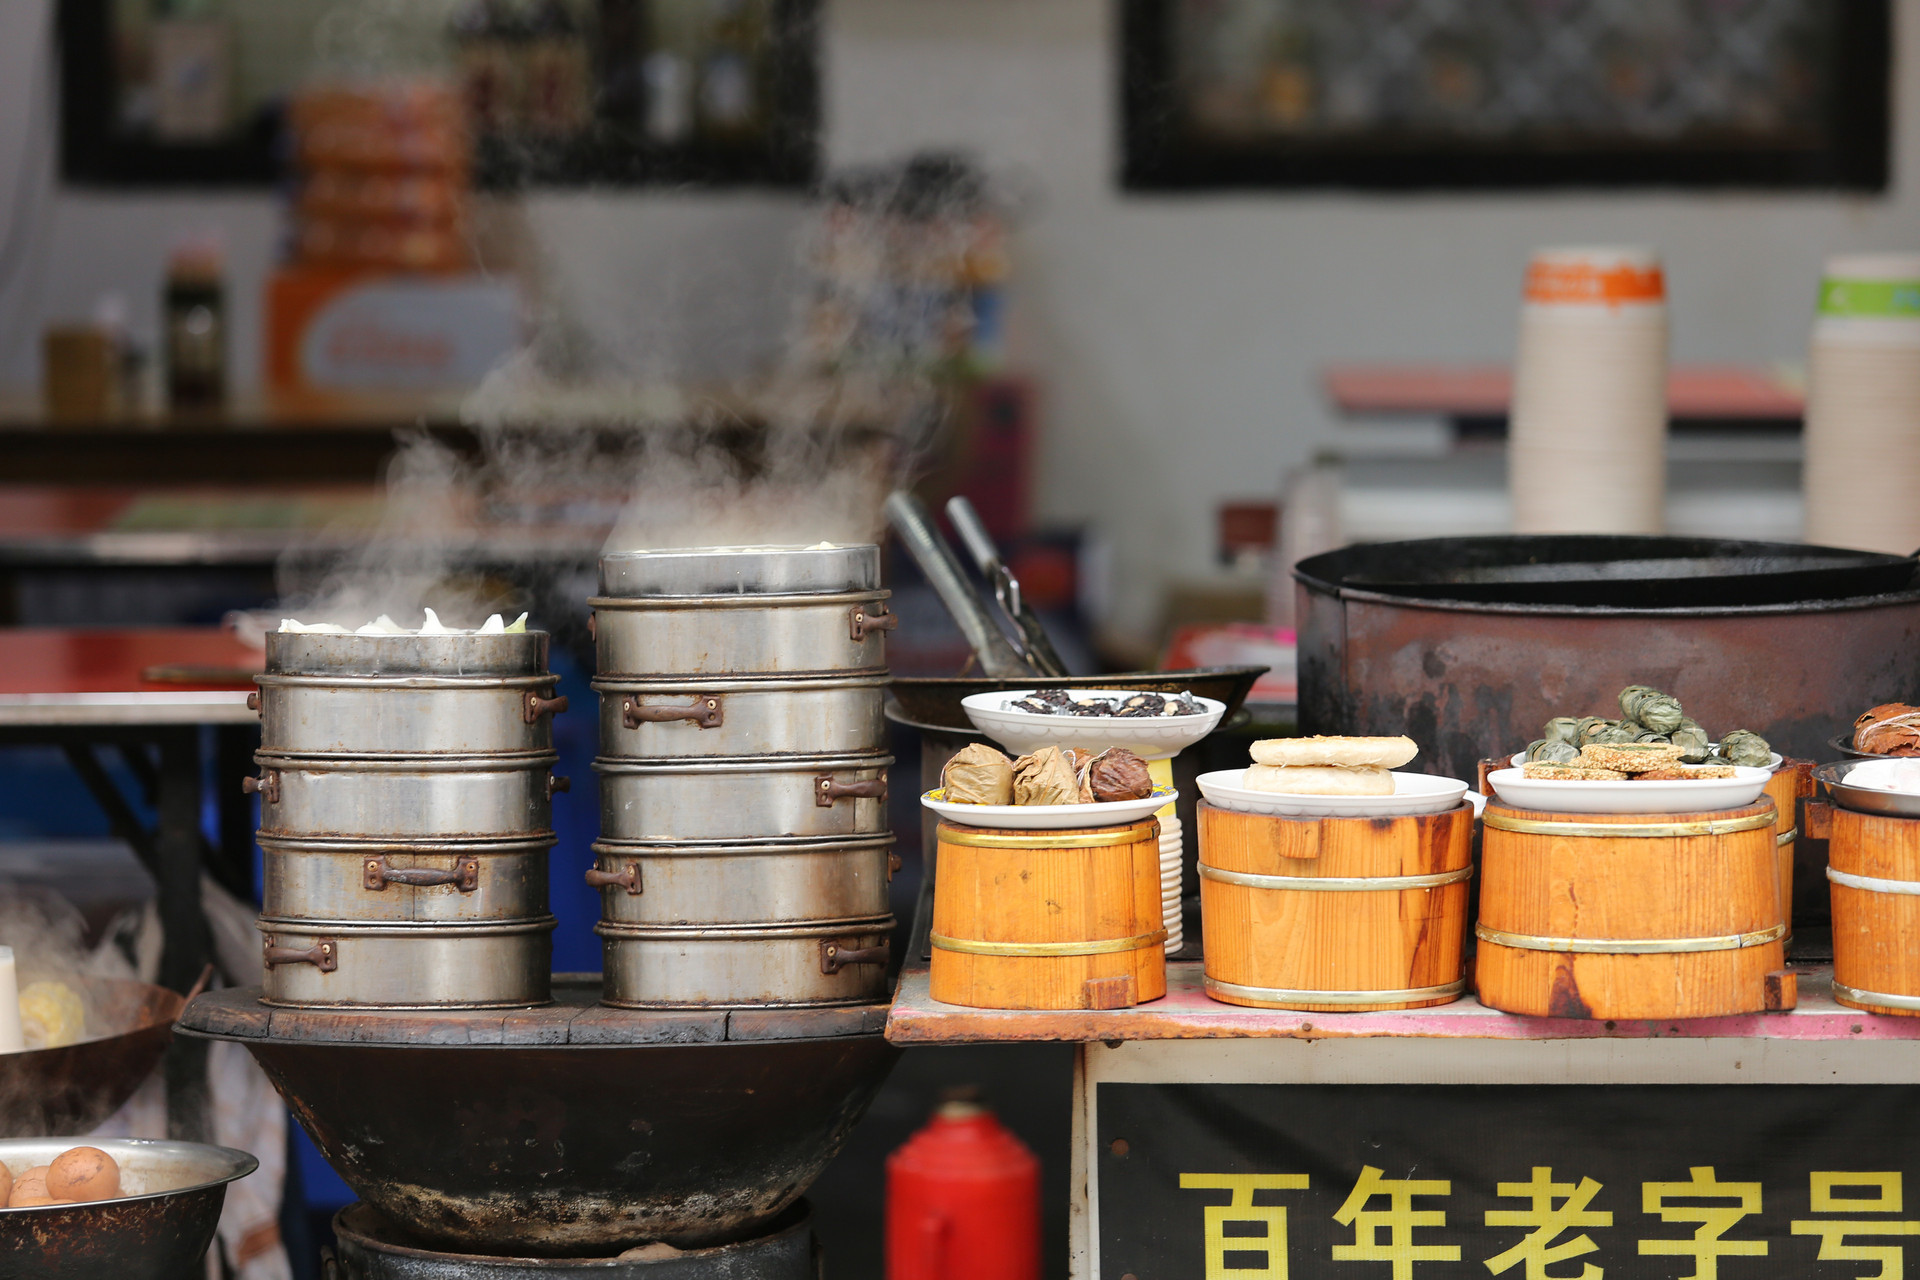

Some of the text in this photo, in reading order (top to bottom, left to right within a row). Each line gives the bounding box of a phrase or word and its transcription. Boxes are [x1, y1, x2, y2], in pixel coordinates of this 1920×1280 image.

[1179, 1165, 1920, 1280] 百年老字号
